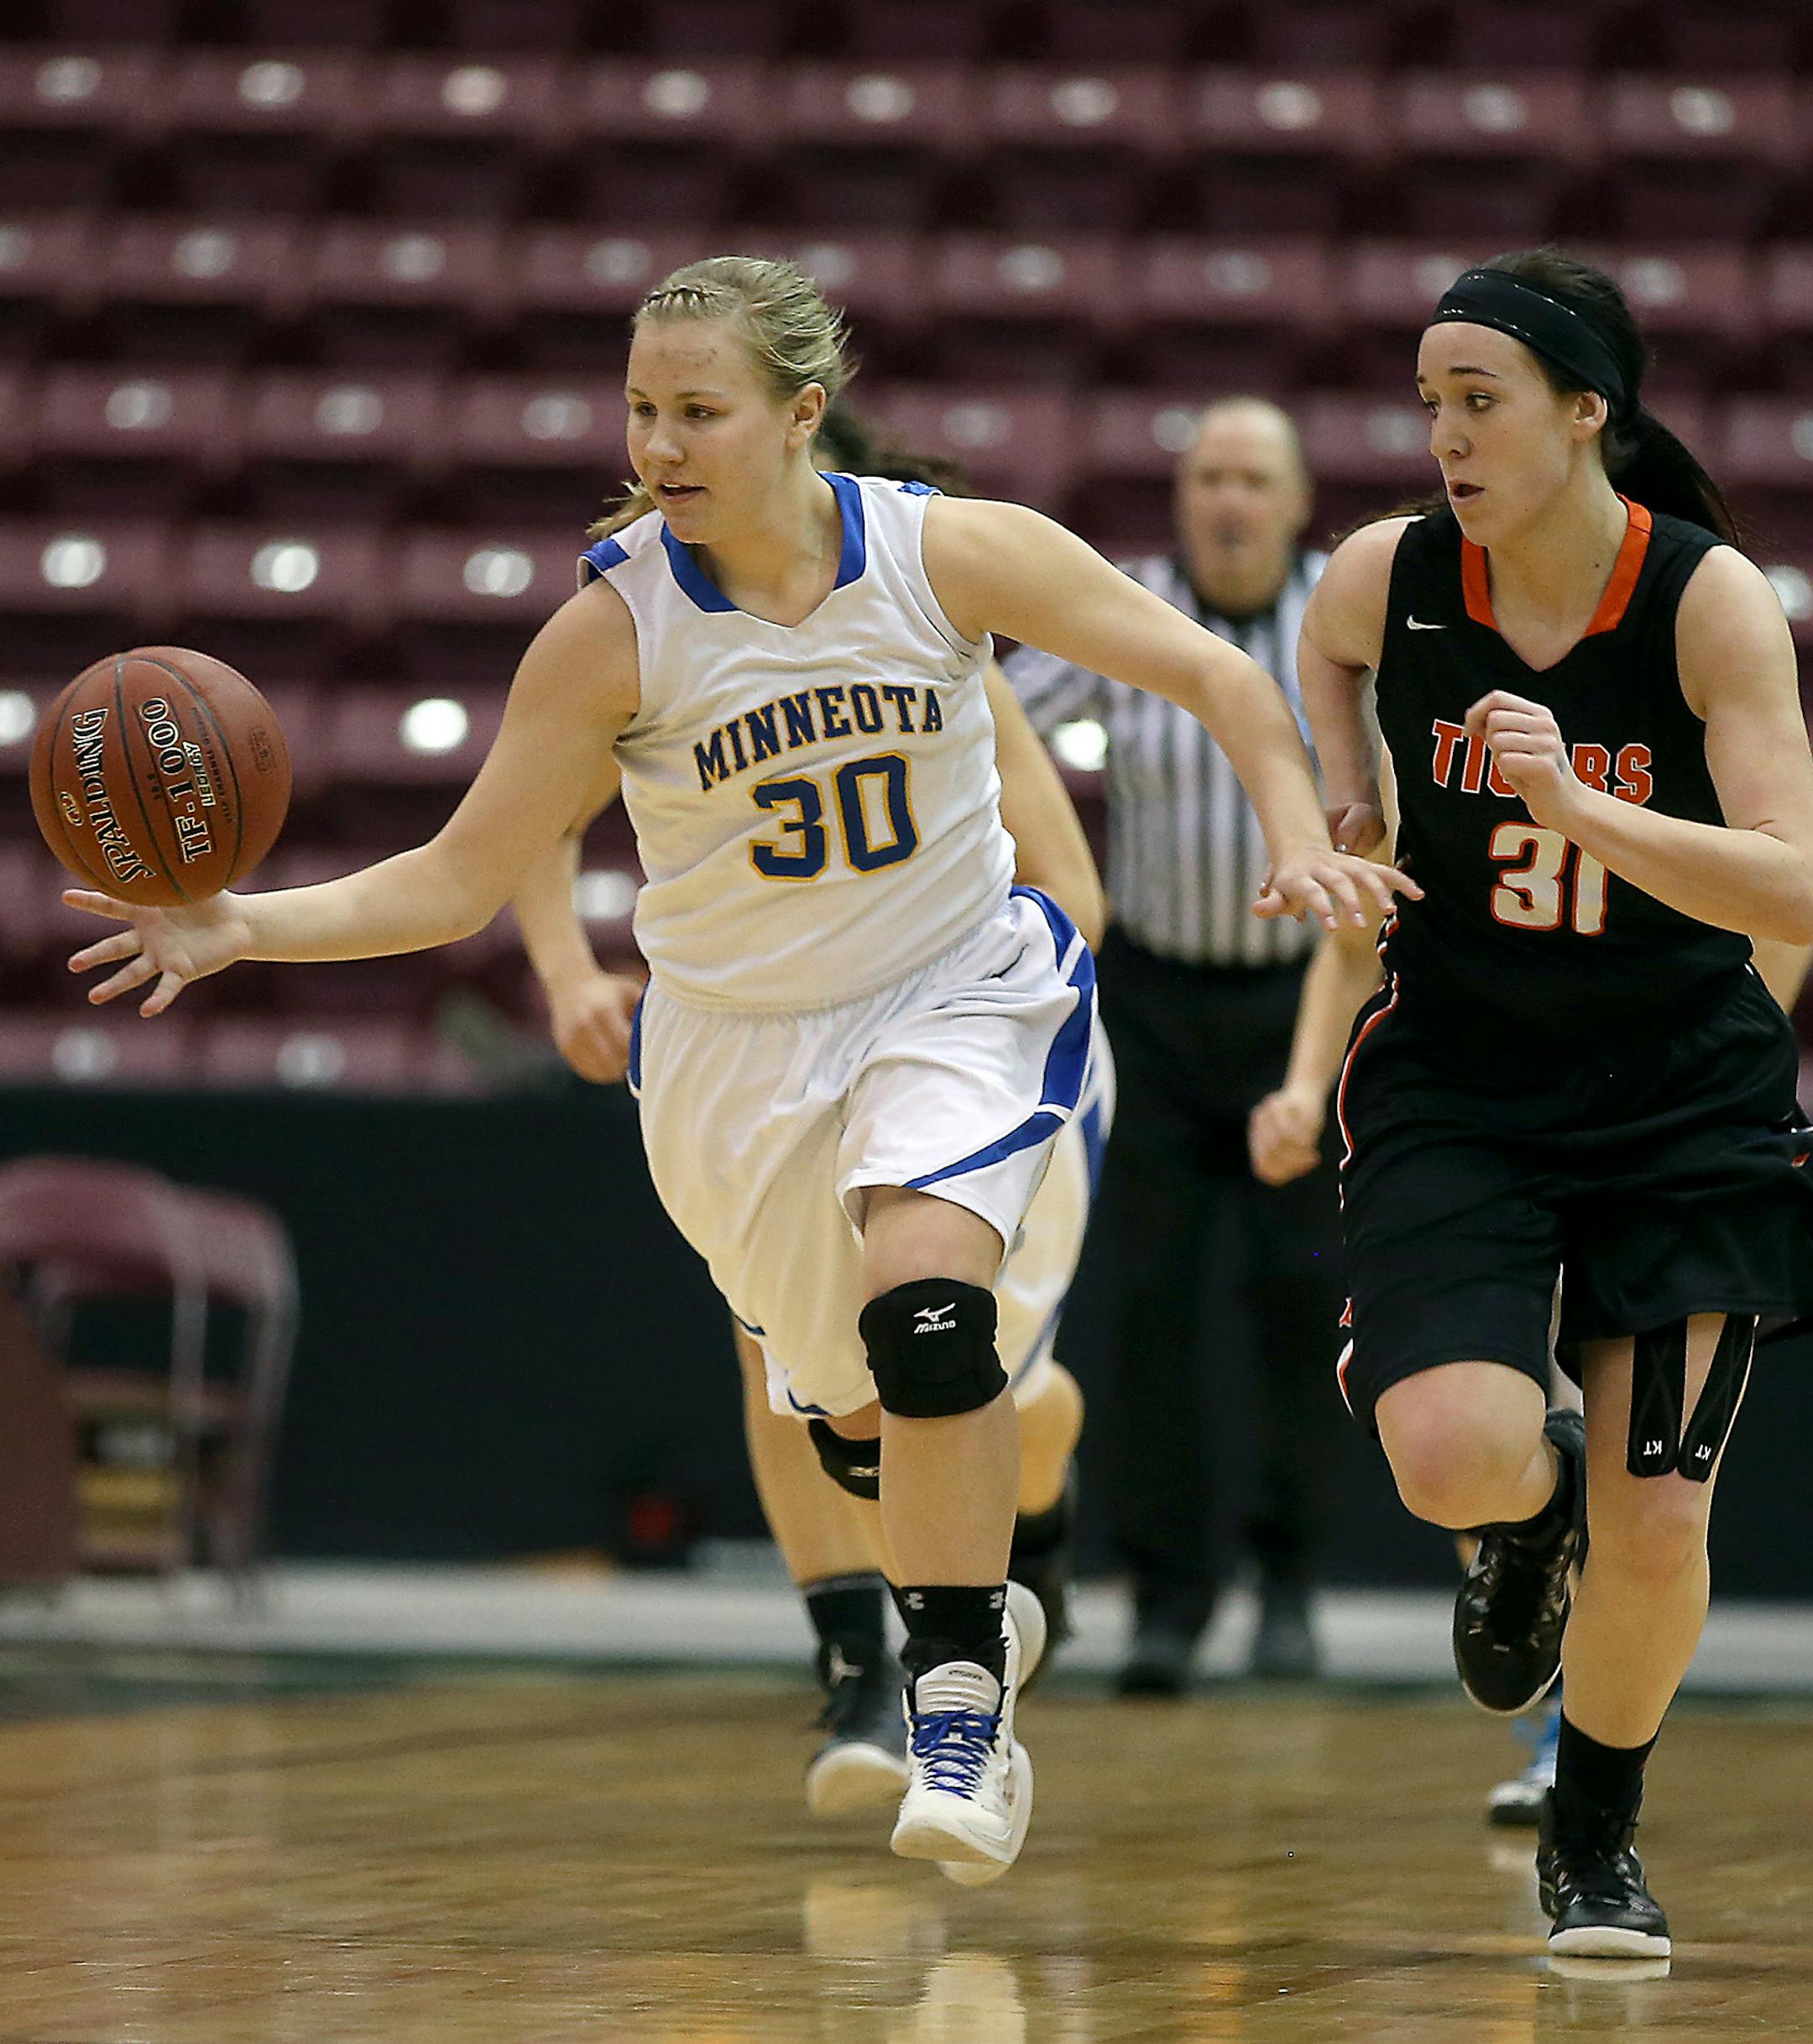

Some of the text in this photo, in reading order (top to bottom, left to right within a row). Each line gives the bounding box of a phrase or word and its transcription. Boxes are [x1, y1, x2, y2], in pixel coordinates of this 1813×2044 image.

[138, 697, 212, 864] TF-1000
[693, 684, 943, 792] MINNEOTA
[1432, 719, 1653, 806] TIRS
[71, 707, 156, 883] SPALDING
[749, 750, 922, 881] 30
[1488, 821, 1609, 936] 31
[1643, 1440, 1663, 1456] KT
[1695, 1444, 1712, 1461] KT
